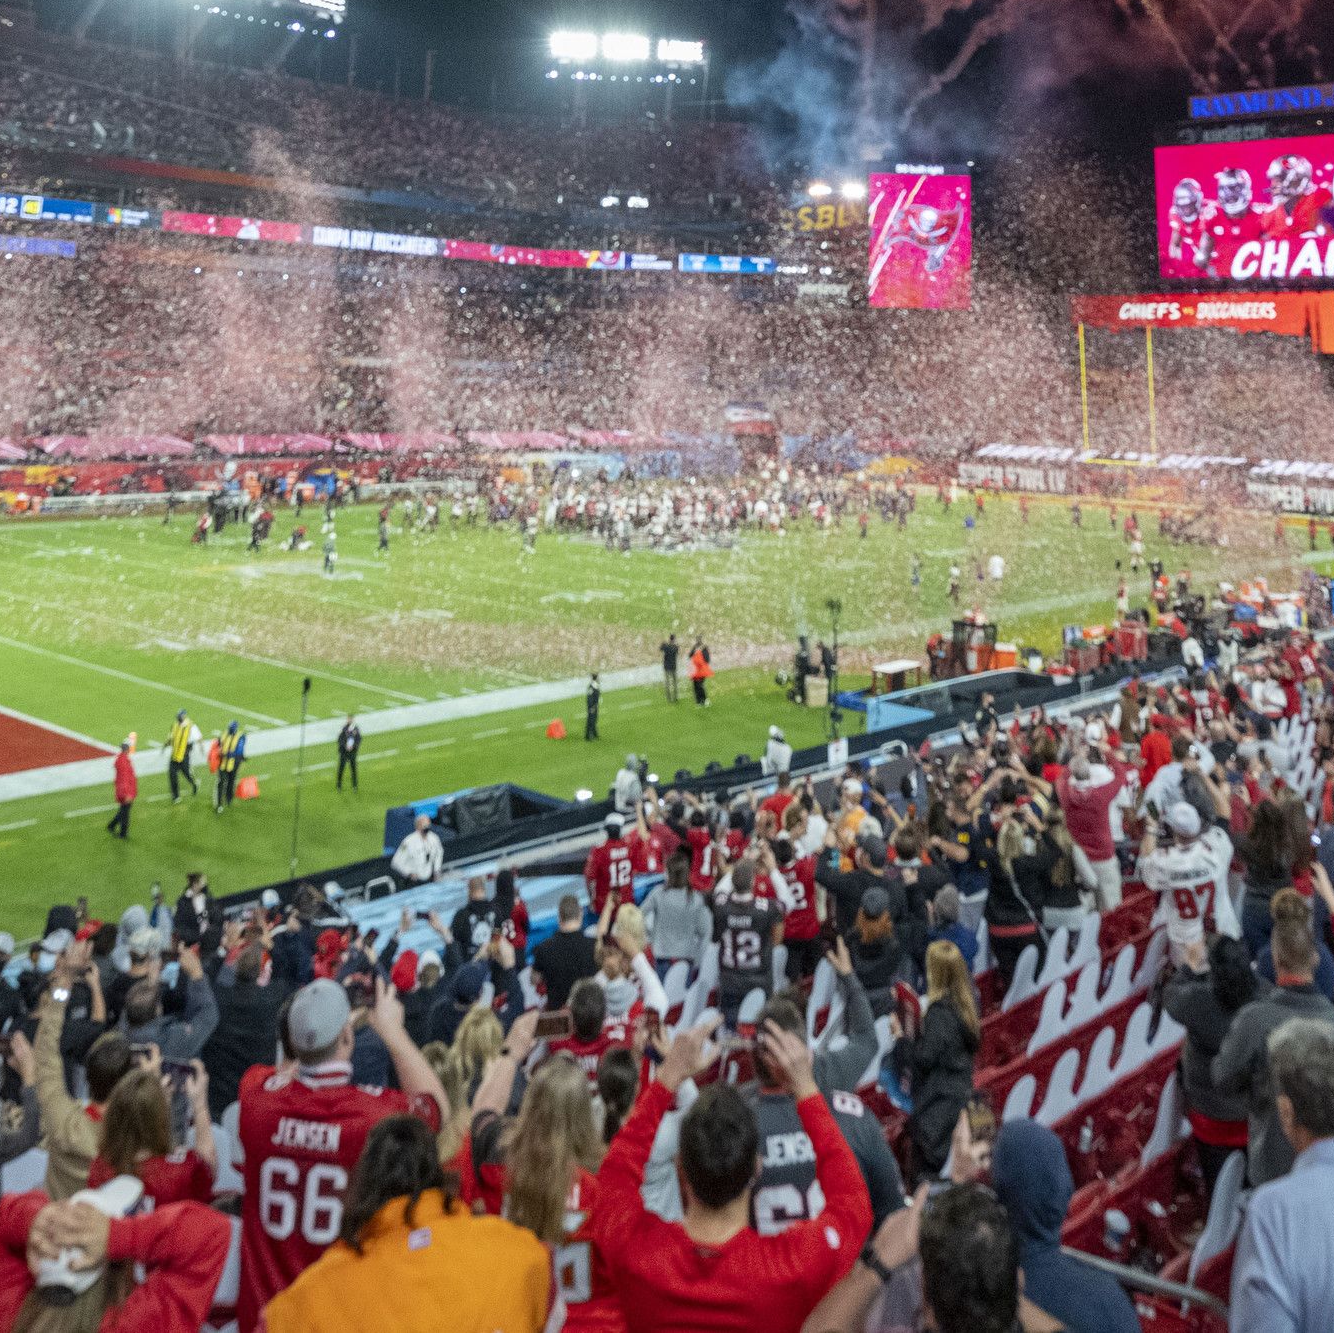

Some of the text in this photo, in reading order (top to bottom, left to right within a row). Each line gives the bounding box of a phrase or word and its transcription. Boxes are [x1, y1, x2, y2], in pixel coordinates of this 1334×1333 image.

[1190, 87, 1321, 119] RAYMOND
[1118, 301, 1182, 321] CHIEFS
[1196, 301, 1278, 321] BUCCANEERS
[609, 859, 632, 888] 12
[1173, 879, 1216, 921] 87
[721, 928, 762, 968] 12
[271, 1116, 342, 1153] JENSEN
[259, 1156, 349, 1246] 66
